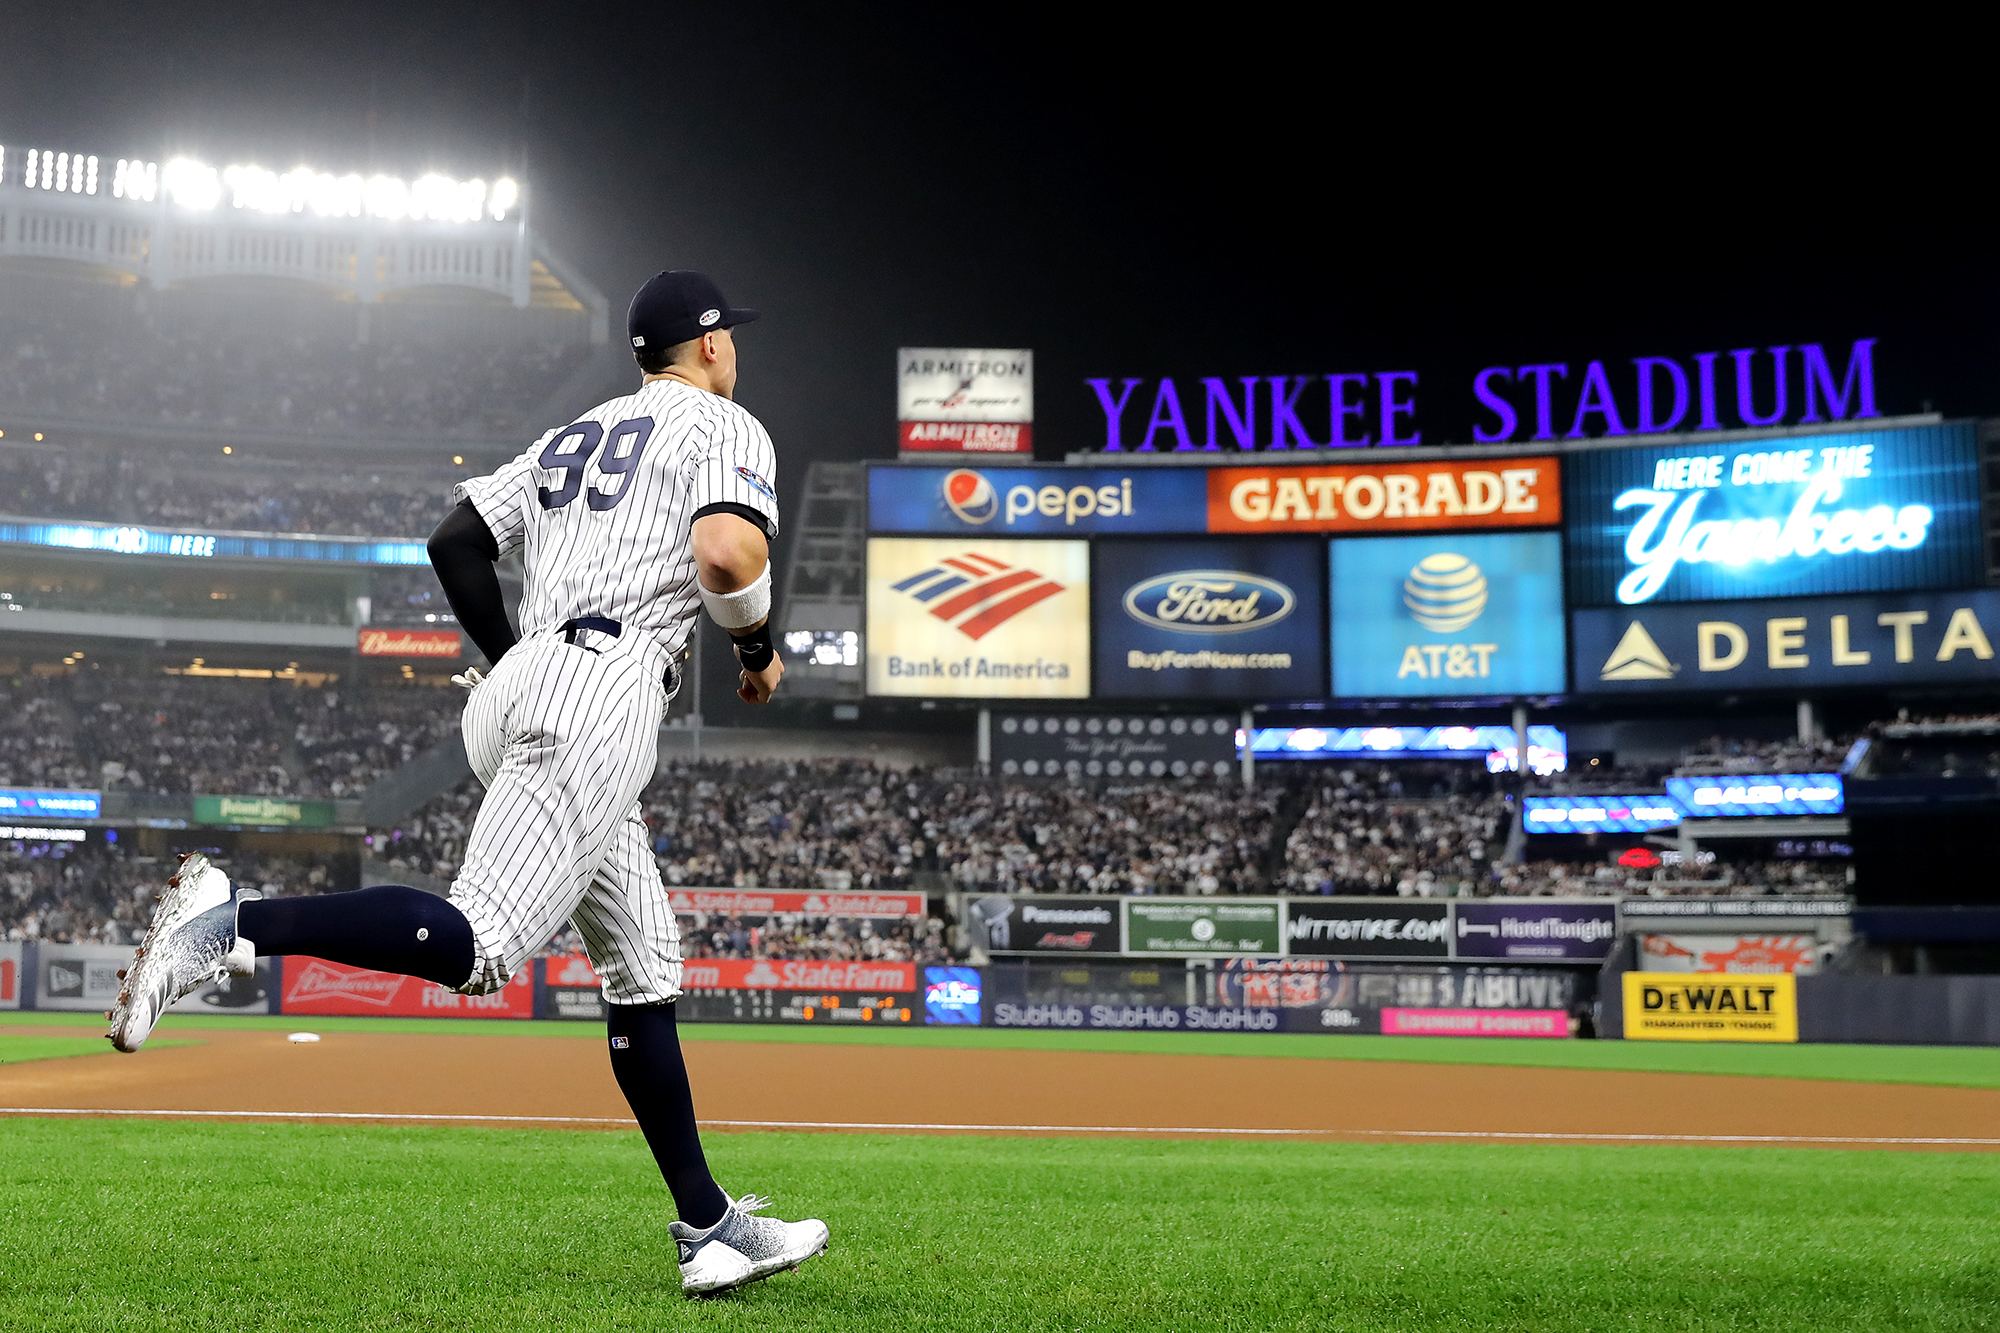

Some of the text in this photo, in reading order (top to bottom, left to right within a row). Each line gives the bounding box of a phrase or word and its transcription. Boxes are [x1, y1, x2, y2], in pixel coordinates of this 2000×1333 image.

[905, 360, 1025, 376] ARMITRON
[1084, 337, 1883, 452] YANKEE STADIUM
[908, 423, 1021, 441] ARMITRON
[538, 416, 655, 511] 99
[1653, 444, 1875, 491] HERE COME THE
[1005, 477, 1133, 525] pepsi
[1229, 468, 1539, 522] GATORADE
[169, 535, 216, 556] HERE
[1614, 472, 1934, 605] Yankees
[1157, 580, 1262, 622] Ford
[361, 631, 460, 653] Budweiser
[1698, 608, 1995, 671] DELTA
[888, 656, 1069, 679] Bank of America
[1398, 643, 1497, 680] AT&T
[1022, 905, 1112, 924] Panasonic
[422, 986, 460, 1008] FOR
[994, 1003, 1083, 1026] StubHub
[1090, 1005, 1179, 1028] StubHub
[1185, 1006, 1277, 1030] StubHub
